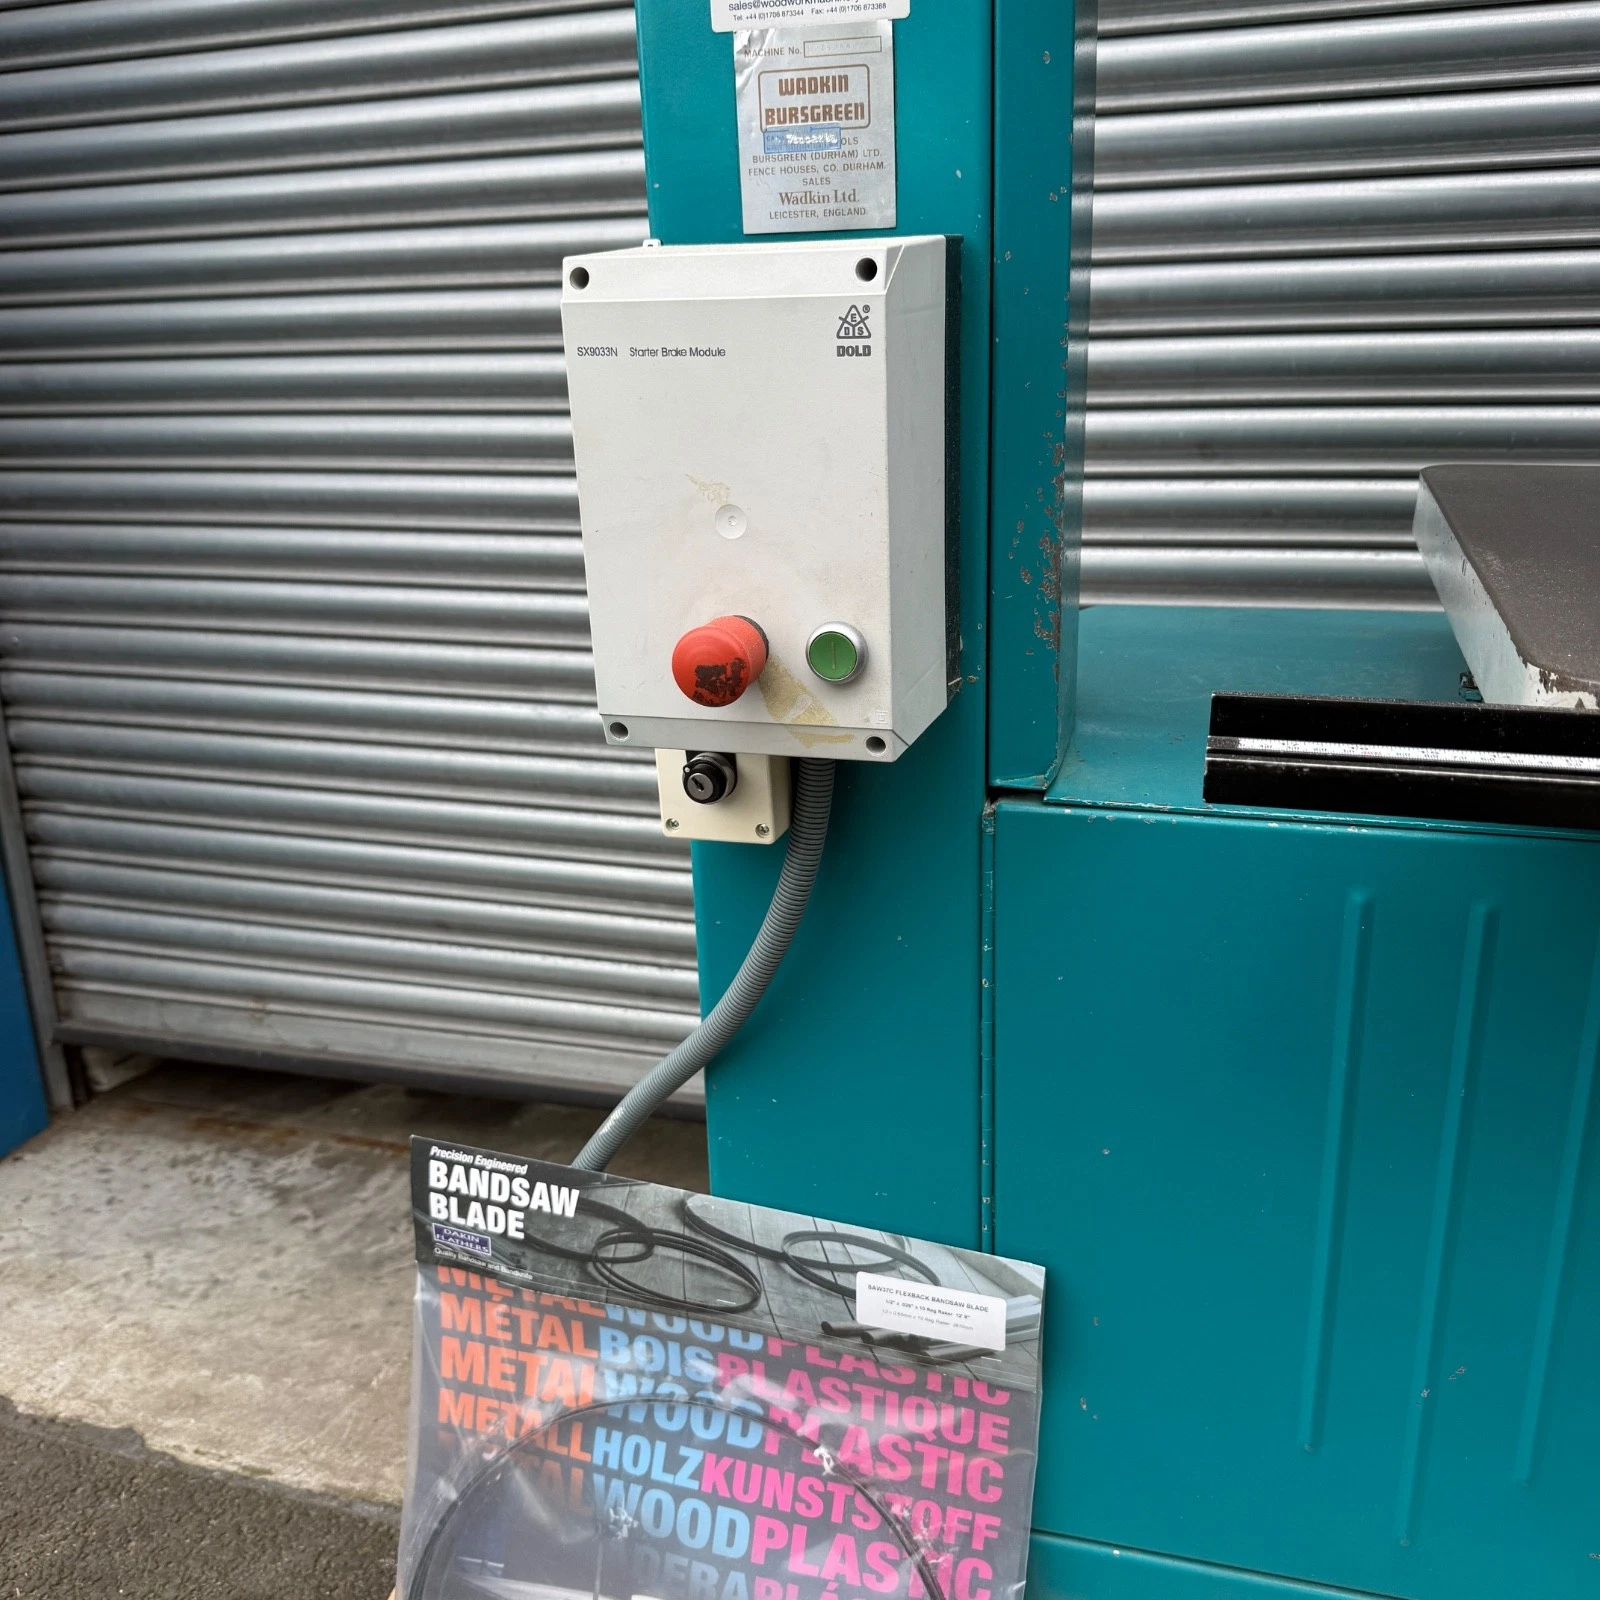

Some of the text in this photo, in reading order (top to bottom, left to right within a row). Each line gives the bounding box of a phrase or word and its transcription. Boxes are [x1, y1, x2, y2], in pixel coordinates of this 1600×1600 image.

[744, 46, 785, 58] MACHINE
[788, 46, 802, 55] No.
[778, 74, 849, 96] WADKIN
[765, 102, 865, 125] BURSGREEN
[752, 153, 807, 164] BURSGREEN
[810, 149, 859, 161] (DURHAM)
[748, 166, 776, 176] FENCE
[780, 164, 819, 174] HOUSES,
[823, 164, 839, 173] CO.
[802, 177, 831, 186] SALES
[779, 188, 860, 206] Wadkin Ltd.
[769, 209, 819, 220] LEICESTER,
[577, 346, 726, 357] SX9033N Starter Brake Module
[836, 344, 872, 357] DOLD
[429, 1145, 528, 1175] Precision Engineered
[429, 1159, 580, 1218] BANDSAW
[429, 1191, 525, 1239] BLADE
[436, 1234, 489, 1253] FLATHERS
[443, 1228, 480, 1242] DAKIN
[895, 1289, 930, 1301] FLEXBACK
[931, 1296, 965, 1308] BANDSAW
[966, 1303, 990, 1313] BLADE
[440, 1291, 1010, 1455] MÉTAL BOIS PLASTIQUE
[603, 1369, 764, 1449] WOOD
[764, 1404, 1004, 1503] PLASTIC
[592, 1427, 705, 1490] HOLZ
[700, 1452, 1002, 1550] KUNSTSTOFF
[592, 1472, 750, 1559] WOOD
